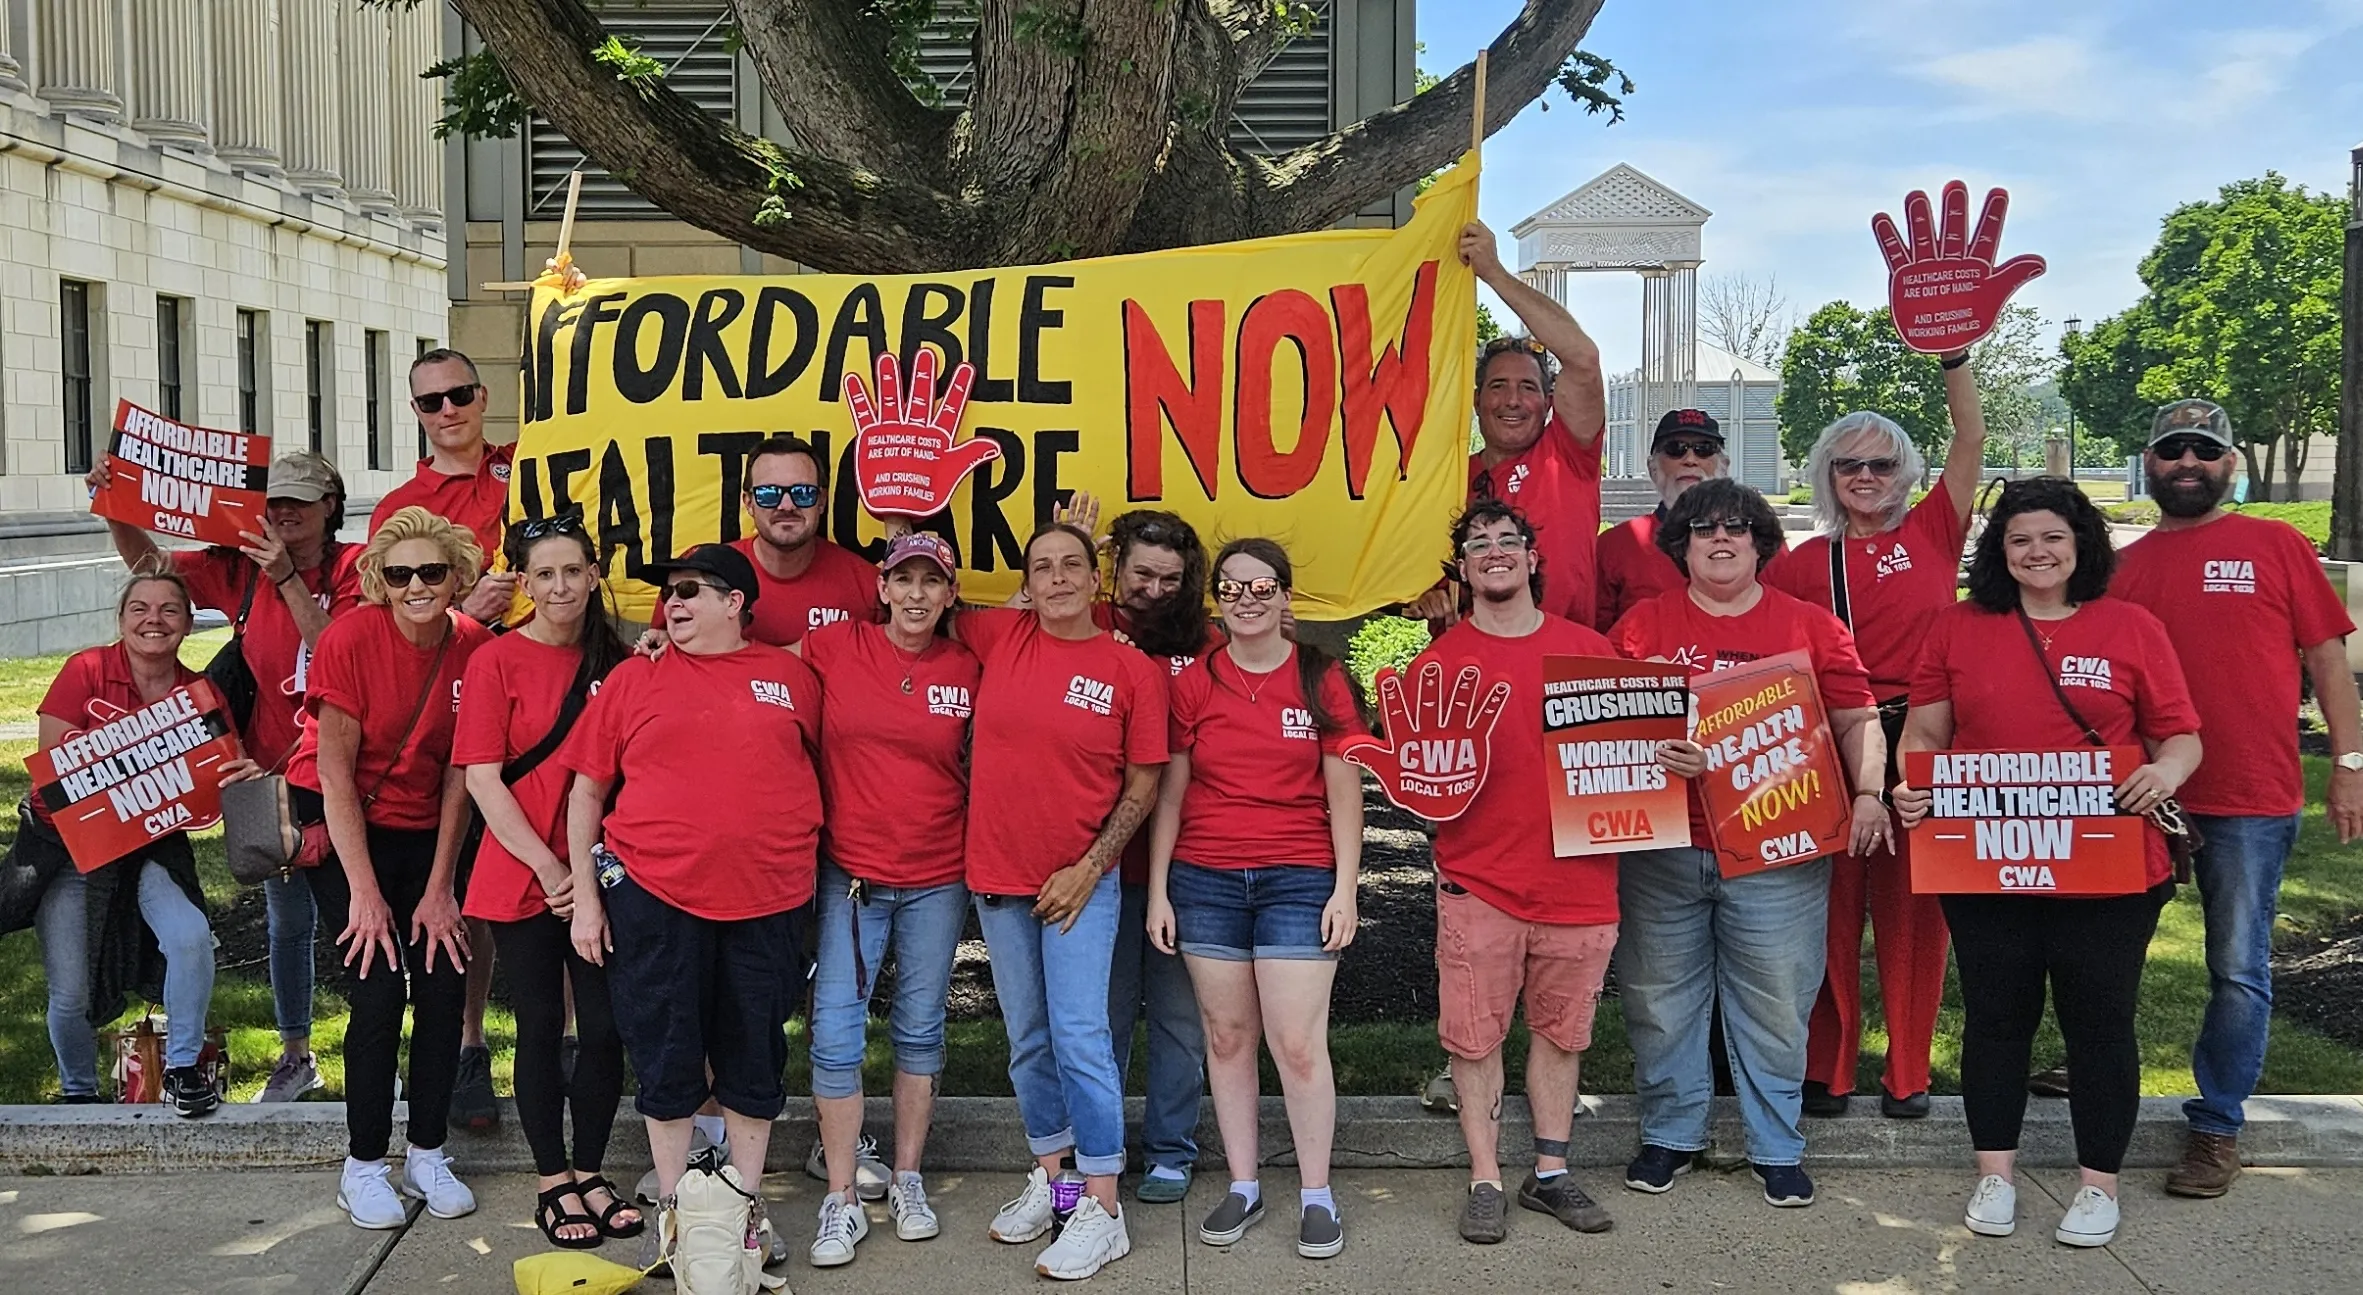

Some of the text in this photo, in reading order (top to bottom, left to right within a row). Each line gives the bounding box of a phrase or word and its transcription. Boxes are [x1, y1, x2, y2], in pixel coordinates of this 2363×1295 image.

[1903, 269, 1980, 285] HEALTHCARE COSTS
[1904, 287, 1920, 298] ARE
[1922, 285, 1938, 297] OUT
[1940, 284, 1951, 295] OF
[1914, 308, 1972, 324] AND CRUSHING
[1907, 320, 1980, 337] WORKING FAMILIES
[1122, 260, 1440, 502] NOW
[124, 407, 248, 462] AFFORDABLE
[868, 434, 941, 449] HEALTHCARE COSTS
[118, 434, 247, 489] HEALTHCARE
[868, 448, 884, 459] ARE
[884, 447, 899, 457] OUT
[901, 447, 912, 457] OF
[874, 472, 931, 487] AND CRUSHING
[141, 469, 212, 517] NOW
[868, 485, 935, 502] WORKING FAMILIES
[154, 511, 195, 535] CWA
[2204, 560, 2255, 579] CWA
[2203, 584, 2231, 592] LOCAL
[1716, 650, 1759, 660] WHEN
[2061, 655, 2111, 678] CWA
[751, 680, 791, 702] CWA
[928, 685, 970, 706] CWA
[1070, 675, 1114, 704] CWA
[1544, 676, 1685, 695] HEALTHCARE COSTS ARE
[2060, 678, 2112, 690] LOCAL 1036
[929, 707, 955, 717] LOCAL
[1064, 695, 1111, 716] LOCAL 1036
[1545, 691, 1684, 727] CRUSHING
[1696, 677, 1796, 739] AFFORDABLE
[50, 690, 198, 776] AFFORDABLE
[1283, 730, 1308, 739] LOCAL
[1702, 704, 1804, 772] HEALTH
[60, 716, 213, 803] HEALTHCARE
[1399, 738, 1477, 773] CWA
[1731, 736, 1809, 791] CARE
[1566, 764, 1667, 796] FAMILIES
[1932, 751, 2113, 785] AFFORDABLE
[107, 756, 195, 823] NOW
[1400, 778, 1475, 797] LOCAL 1036
[1740, 769, 1821, 831] NOW!
[1932, 785, 2115, 817] HEALTHCARE
[144, 802, 192, 834] CWA
[1587, 809, 1653, 838] CWA
[1760, 830, 1818, 861] CWA
[1975, 819, 2073, 860] NOW
[1999, 865, 2056, 887] CWA
